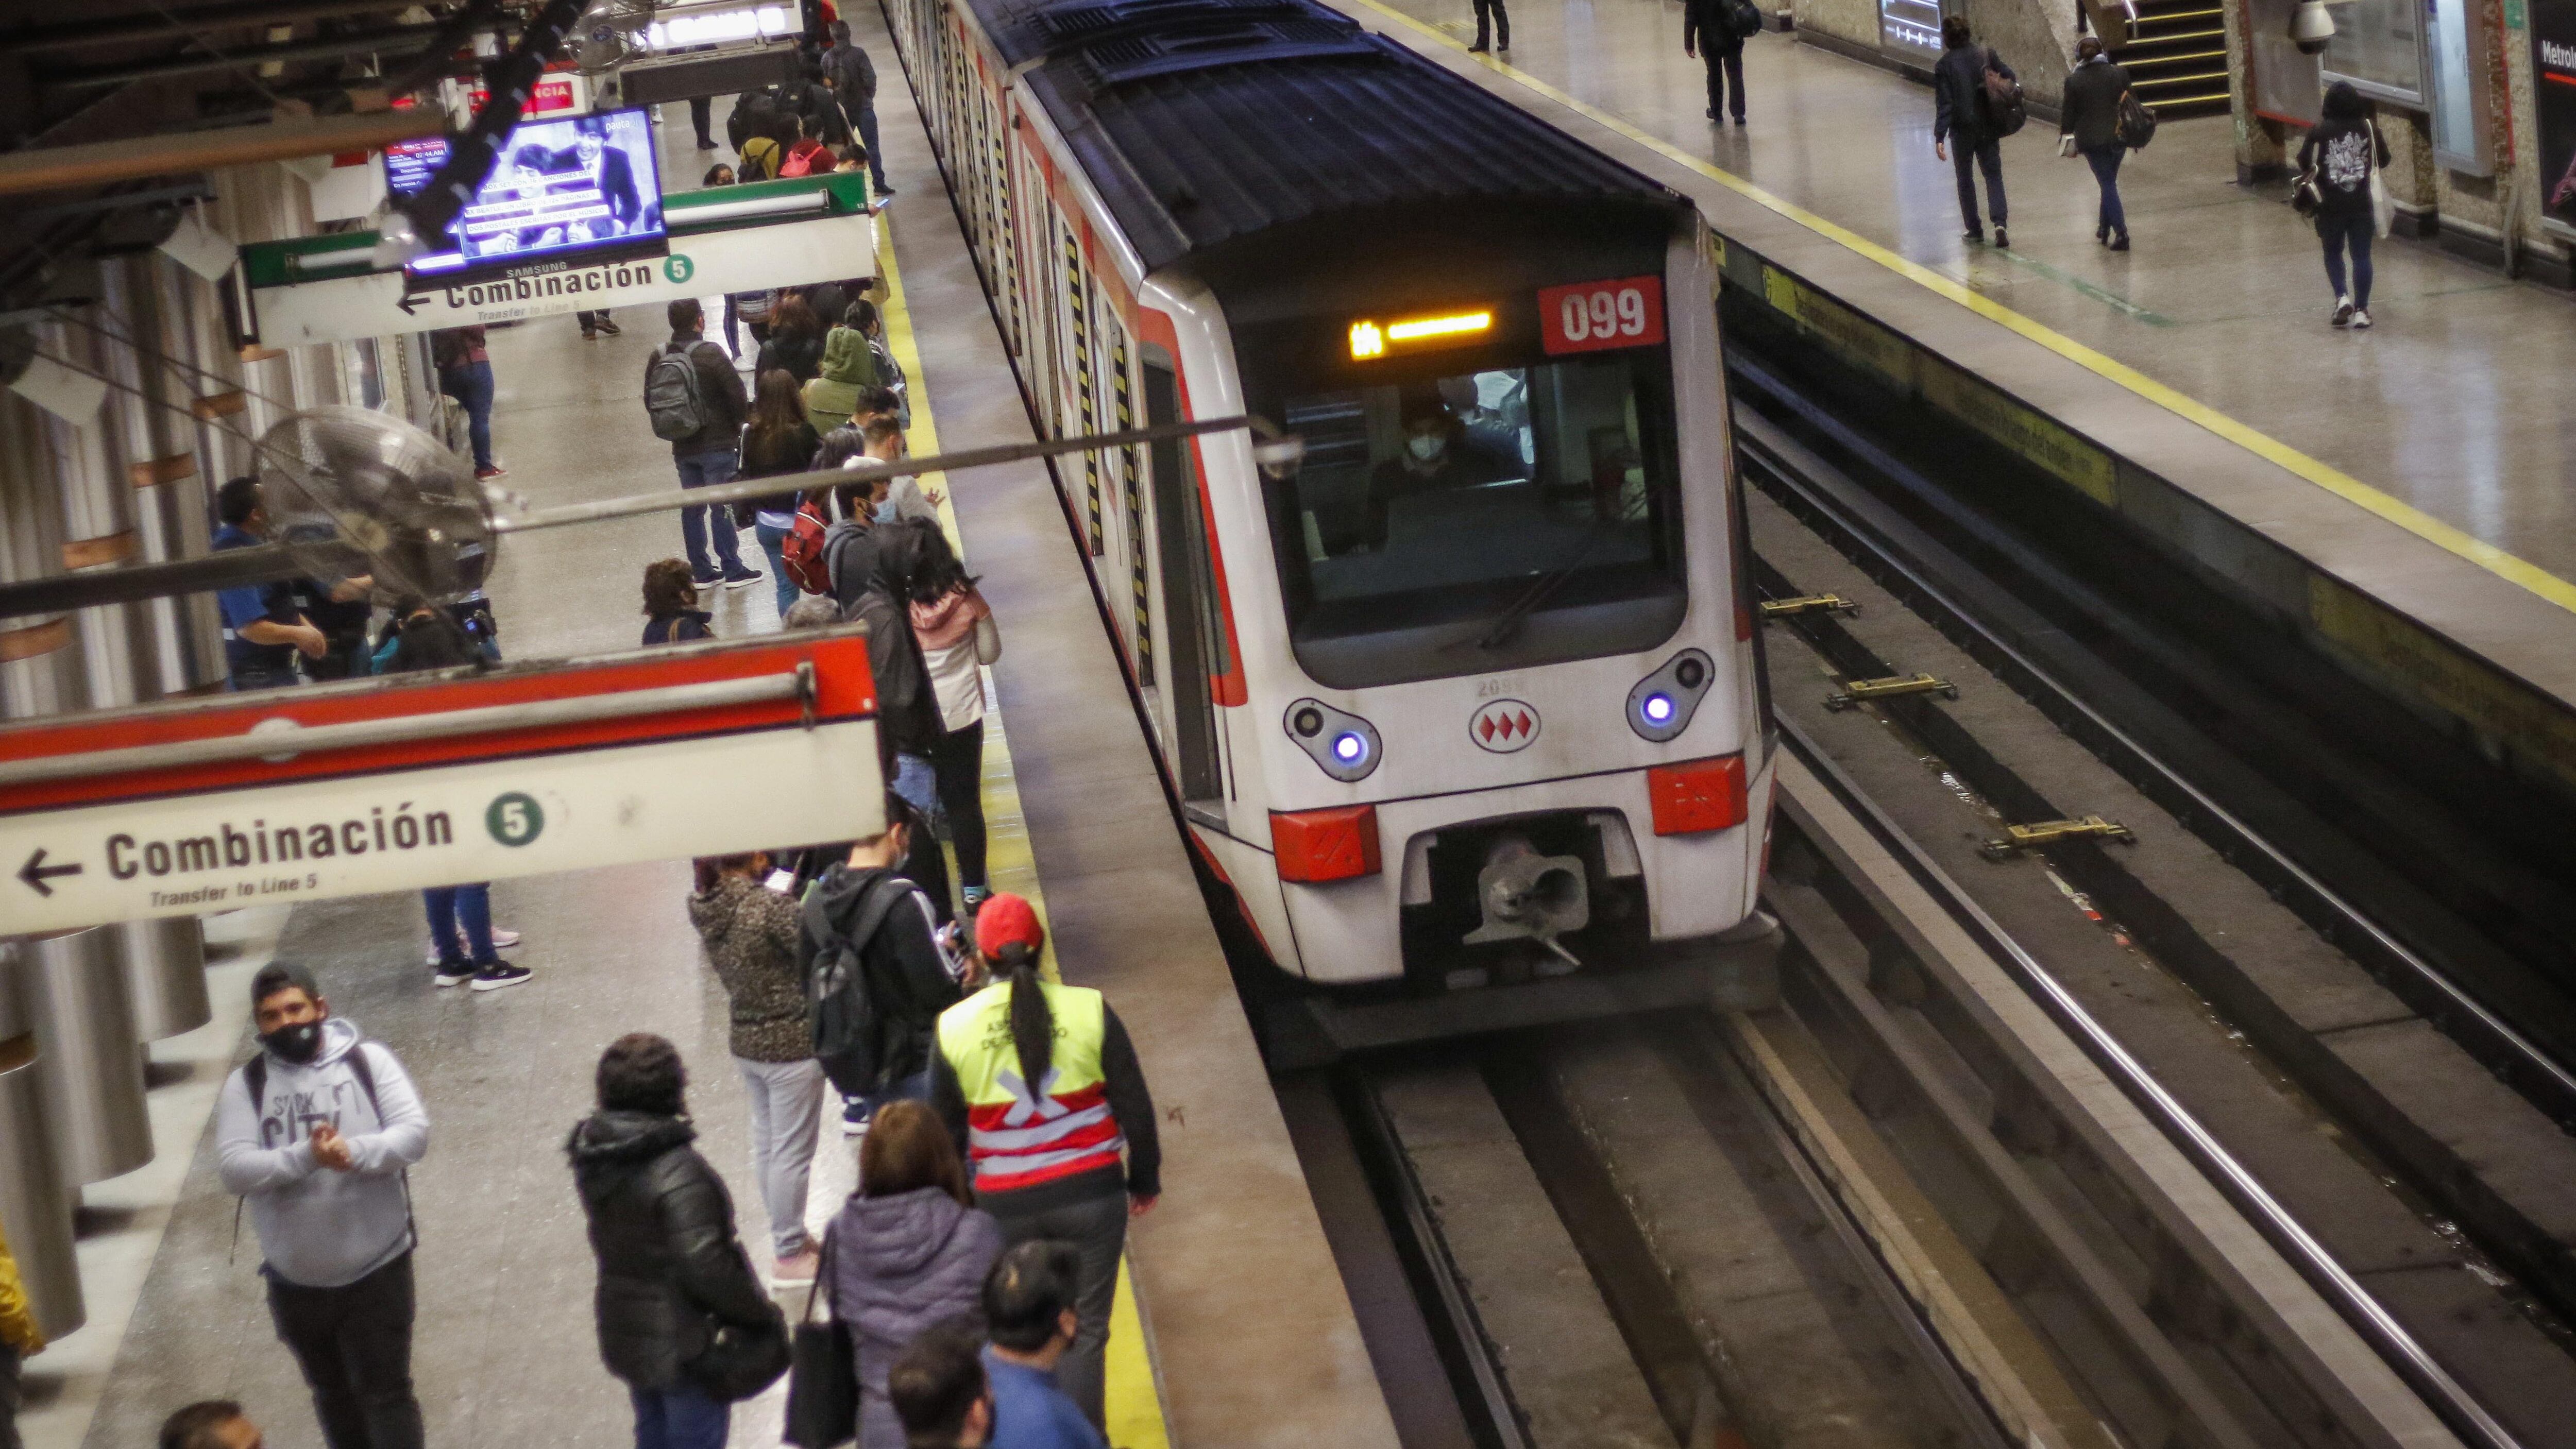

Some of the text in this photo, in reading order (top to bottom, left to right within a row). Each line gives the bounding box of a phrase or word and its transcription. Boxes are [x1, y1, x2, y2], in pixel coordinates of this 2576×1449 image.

[605, 120, 630, 133] pauta
[539, 171, 578, 182] CANCIONES
[485, 220, 518, 229] POSTALES
[520, 215, 552, 224] ESCRITAS
[506, 262, 567, 278] SAMSUNG
[445, 260, 687, 309] Combinación 5
[478, 300, 580, 320] Transfer to Line 5
[1561, 288, 1646, 342] 099
[105, 800, 529, 880] Combinación 5
[150, 874, 317, 907] Transfer to Line 5
